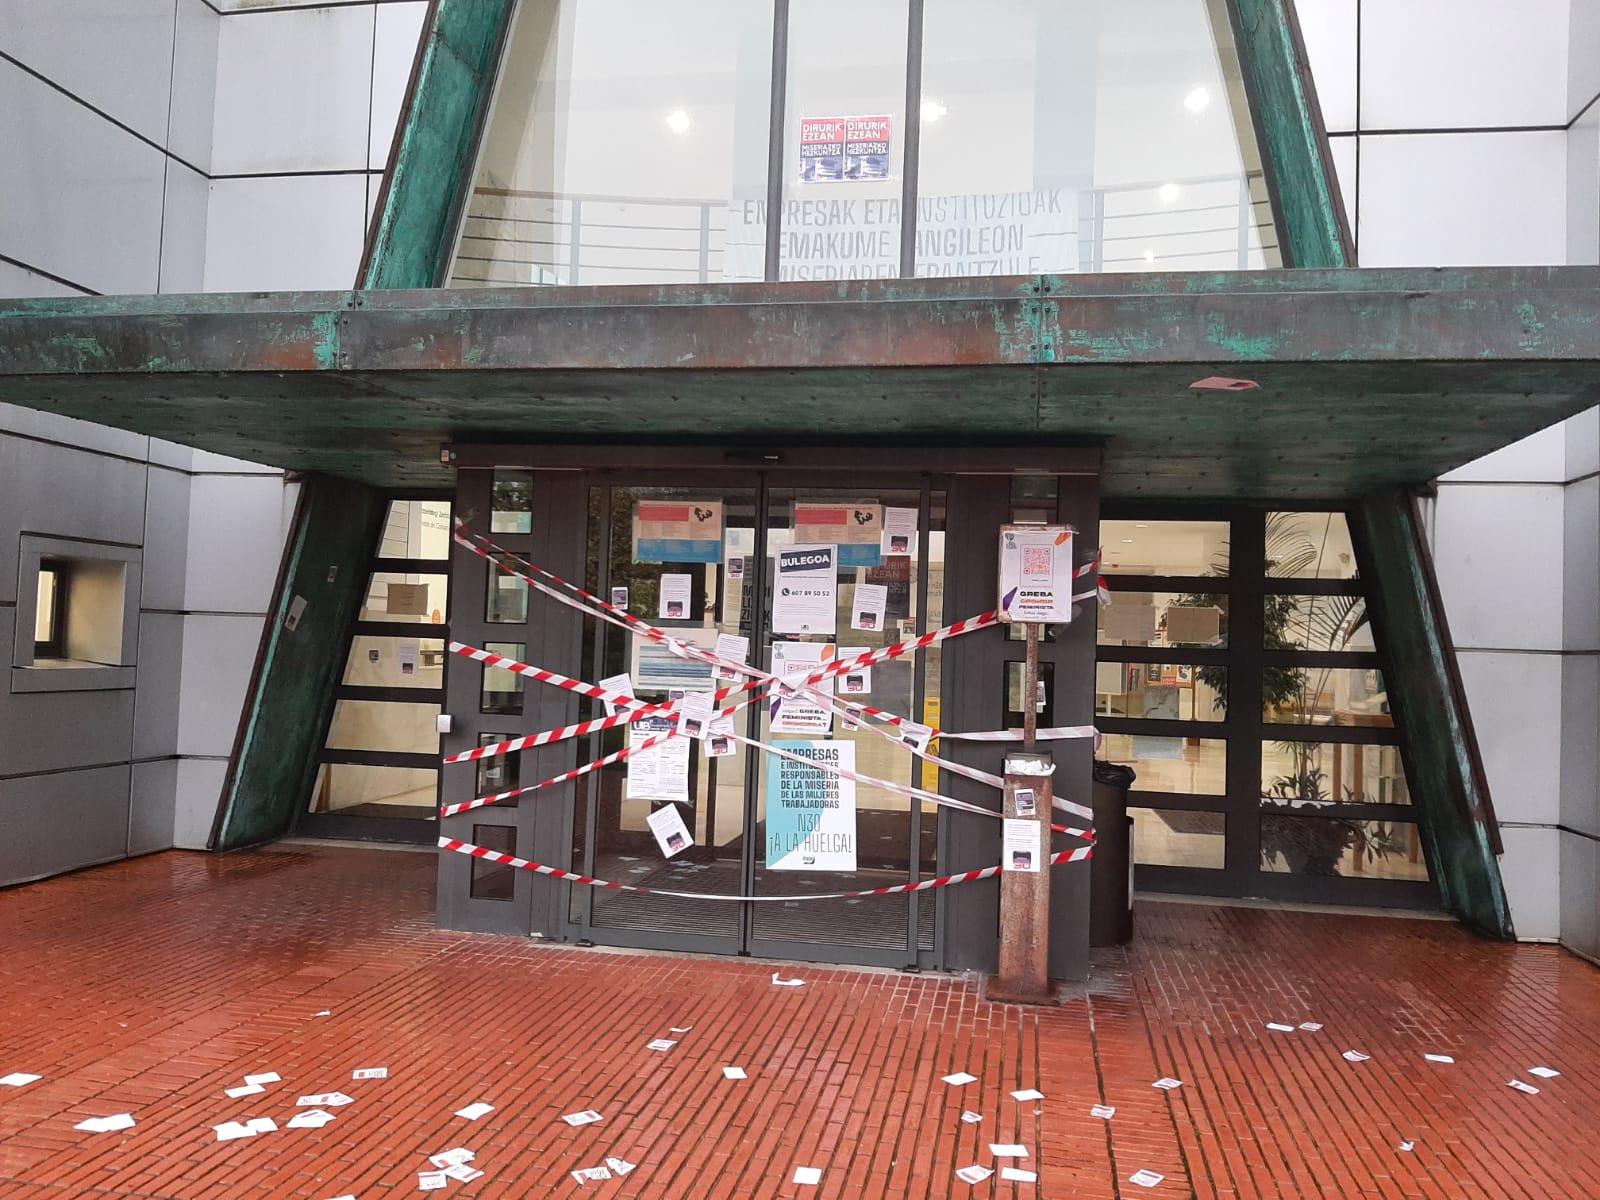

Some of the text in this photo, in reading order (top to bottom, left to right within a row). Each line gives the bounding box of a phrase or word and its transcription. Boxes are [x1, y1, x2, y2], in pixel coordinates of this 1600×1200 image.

[803, 123, 842, 132] DIRURIK
[848, 121, 887, 131] DIRURIK
[803, 132, 835, 141] EZEAN
[848, 131, 881, 140] EZEAN
[864, 198, 900, 225] ETA
[781, 554, 830, 567] BULEGOA
[781, 770, 839, 780] RESPONSABLES
[781, 780, 839, 790] DE LA MISERIA
[781, 790, 839, 800] DE LAS MUJERES
[781, 799, 839, 809] TRABAJADORAS
[798, 813, 821, 832] N30
[769, 832, 852, 856] ¡A LA HUELGA!
